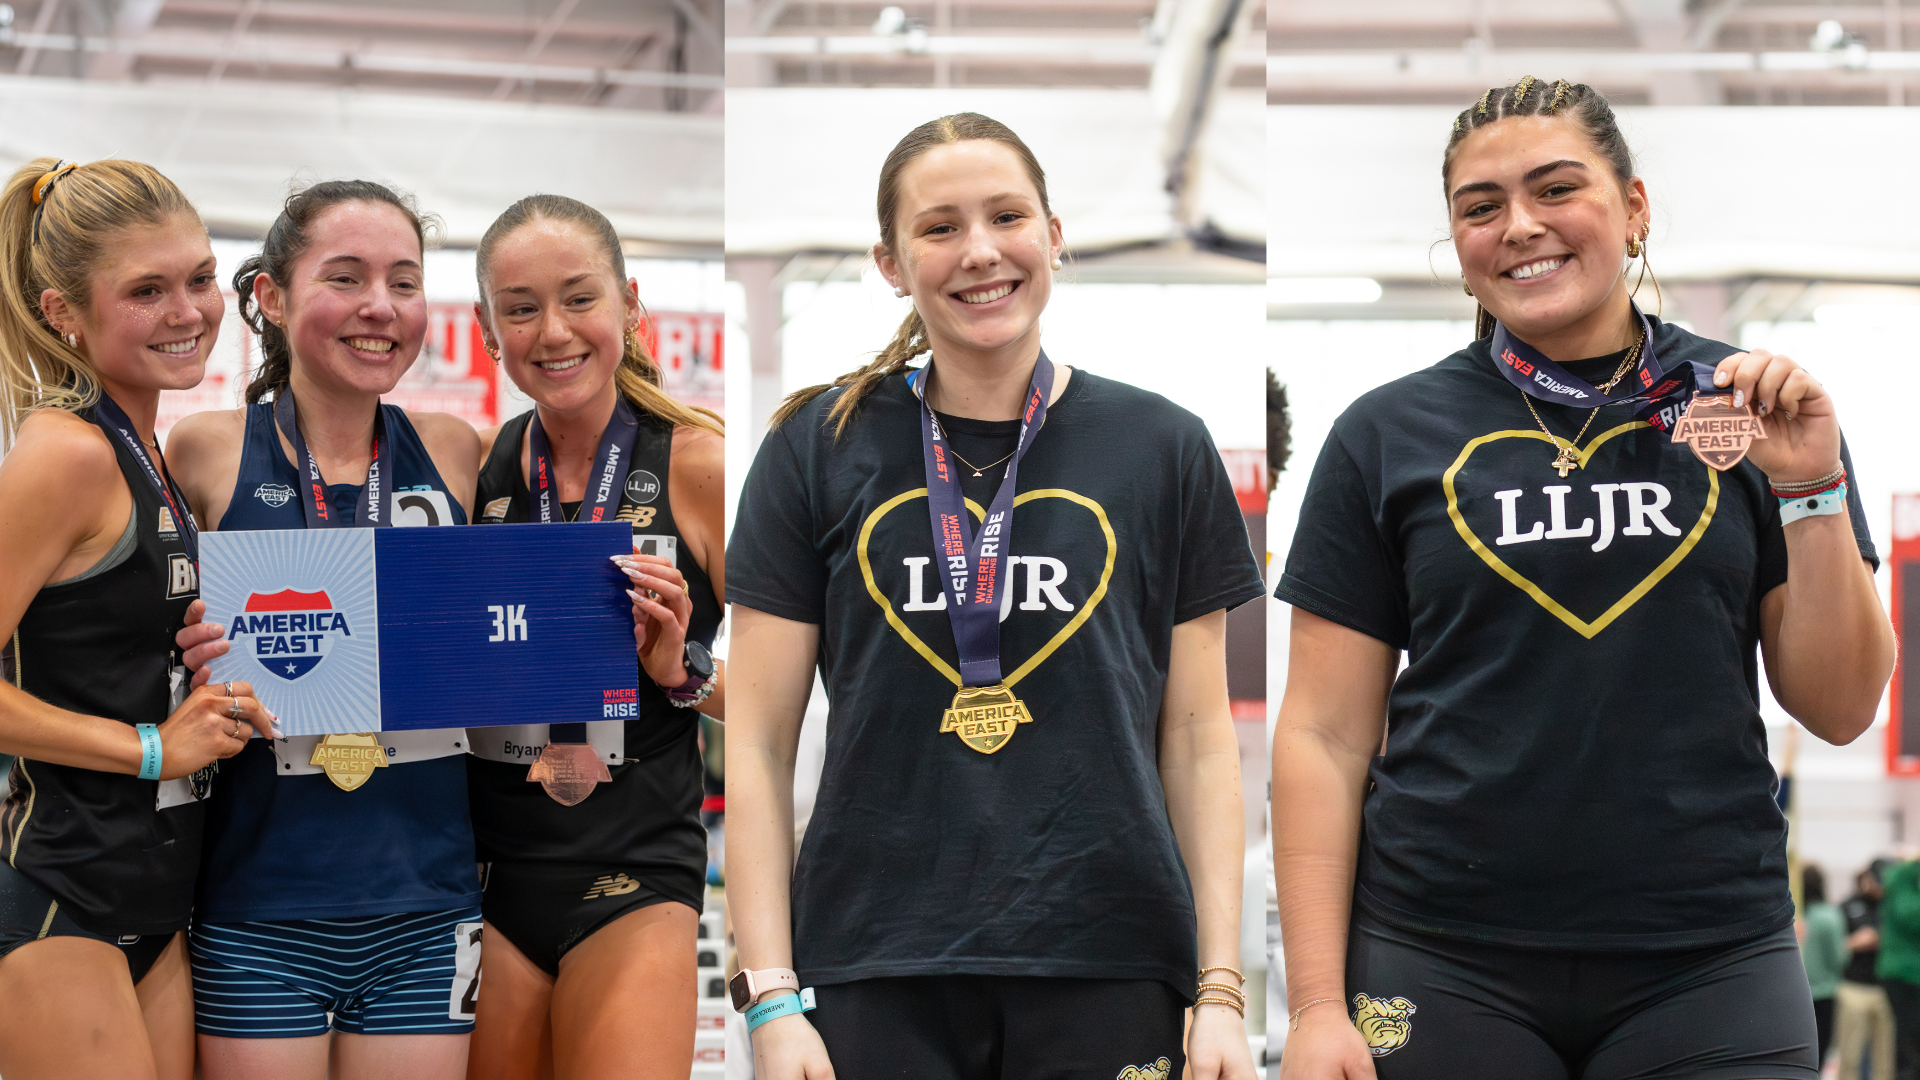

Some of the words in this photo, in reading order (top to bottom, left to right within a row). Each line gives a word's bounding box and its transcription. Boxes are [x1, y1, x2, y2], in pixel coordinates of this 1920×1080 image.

[1501, 348, 1535, 377] EAST
[1534, 370, 1590, 399] AMERICA
[1639, 367, 1653, 389] EA
[1025, 387, 1042, 424] EAST
[1660, 401, 1687, 428] RIS
[1680, 418, 1762, 439] AMERICA
[1698, 435, 1744, 449] EAST
[119, 427, 161, 487] AMERICA
[162, 490, 184, 527] EAST
[538, 456, 548, 490] EAST
[595, 443, 621, 504] AMERICA
[933, 444, 949, 483] EAST
[255, 489, 297, 497] AMERICA
[368, 462, 380, 522] AMERICA
[628, 480, 657, 493] LLJR
[312, 484, 328, 521] EAST
[590, 506, 605, 522] EA
[1493, 481, 1682, 553] LLJR
[940, 513, 954, 556] CHAMPIONS
[947, 514, 965, 556] WHERE
[980, 511, 1005, 557] RISE
[902, 556, 1075, 624] LJR
[974, 557, 990, 604] WHERE
[985, 557, 998, 604] CHAMPIONS
[228, 612, 351, 641] AMERICA
[487, 604, 528, 642] 3K
[256, 634, 324, 655] EAST
[603, 688, 637, 698] WHERE
[603, 703, 638, 718] RISE
[946, 704, 1026, 729] AMERICA
[963, 720, 1009, 736] EAST
[147, 734, 156, 760] AMERICA
[316, 747, 384, 764] AMERICA
[147, 760, 156, 775] EAST
[330, 761, 369, 772] EAST
[758, 1002, 785, 1017] AMERICA
